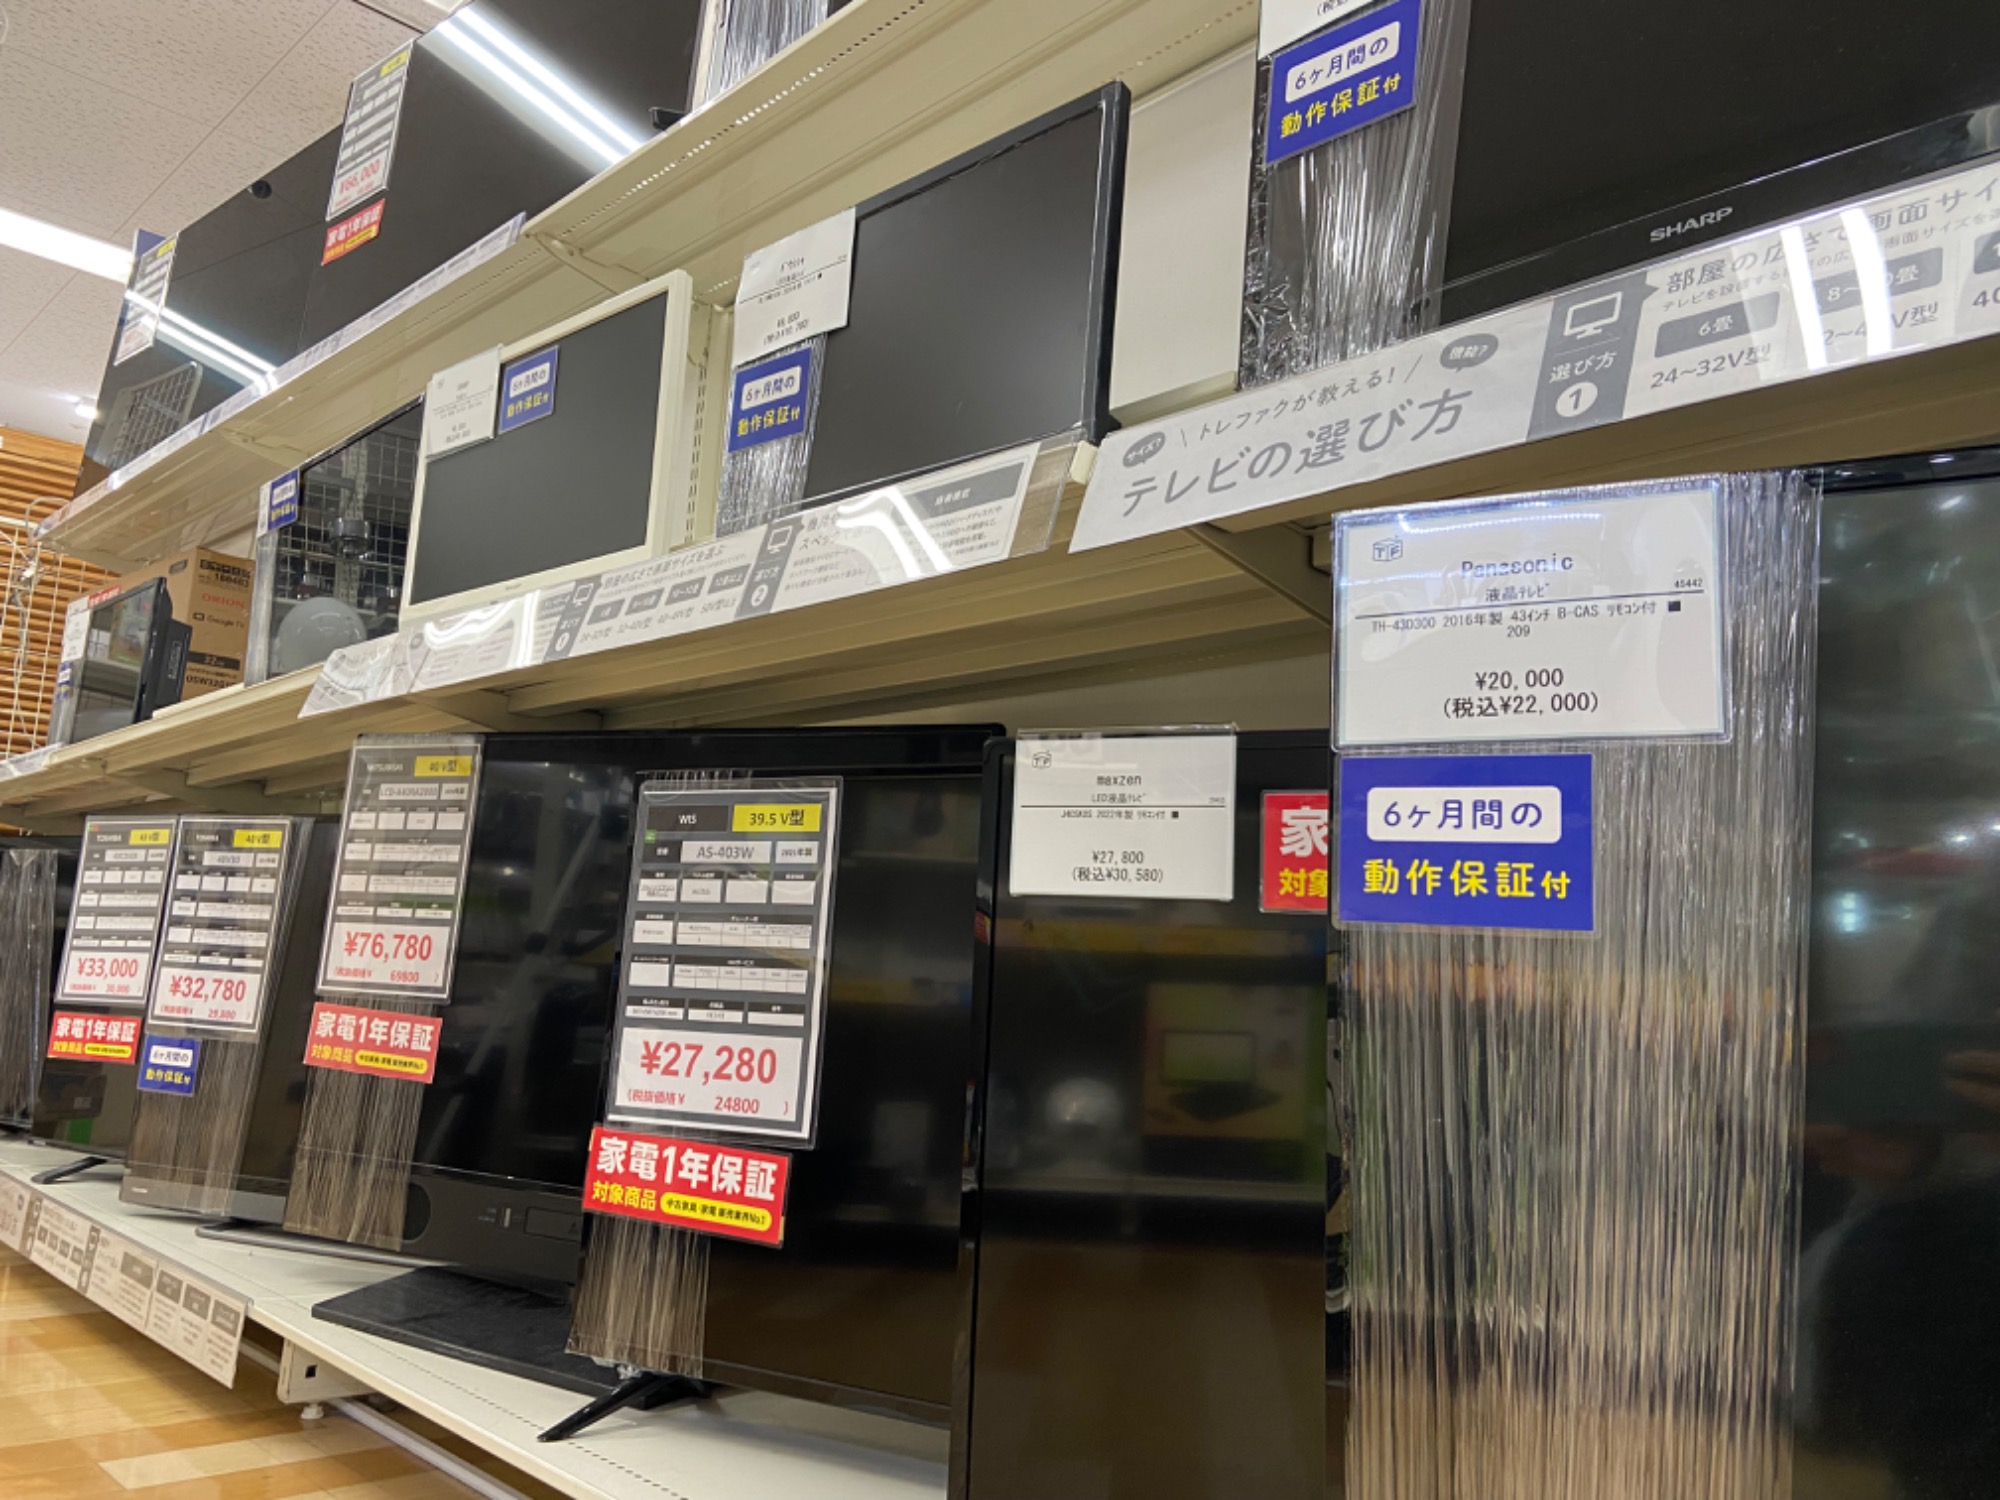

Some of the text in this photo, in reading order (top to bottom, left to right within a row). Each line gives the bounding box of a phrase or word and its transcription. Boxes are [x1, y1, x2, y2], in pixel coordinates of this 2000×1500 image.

[1280, 73, 1401, 139] 動作保証付
[1650, 206, 1733, 242] SHARP
[1699, 314, 1733, 336] 6畳
[1549, 351, 1617, 383] 選び方
[1569, 388, 1582, 411] 1
[1122, 387, 1473, 517] テレビの選び方
[1462, 553, 1574, 579] Panasonic
[755, 588, 764, 602] 2
[1485, 583, 1550, 602] 液晶テレビ
[1674, 578, 1704, 589] 45442
[1443, 613, 1503, 629] 2016年製
[1511, 608, 1551, 623] 43インチ
[1558, 605, 1599, 620] B-CAS
[1507, 625, 1531, 639] 209
[1475, 668, 1565, 691] ¥20,000
[1442, 691, 1599, 720] (税込¥22,000)
[1097, 775, 1141, 786] maxzen
[750, 809, 804, 826] 39.5 V型
[697, 846, 755, 859] AS-403W
[1092, 850, 1144, 865] ¥27,800
[1363, 858, 1571, 900] 動作保証付
[344, 930, 432, 964] ¥76,780
[77, 957, 139, 981] ¥33,000
[169, 974, 247, 1003] ¥32,780
[55, 1017, 138, 1042] 家電1年保証
[315, 1011, 434, 1052] 家電1年保証
[640, 1040, 777, 1086] ¥27,280
[714, 1096, 759, 1114] 24800
[597, 1136, 778, 1201] 家電1年保証
[592, 1180, 657, 1211] 対象商品
